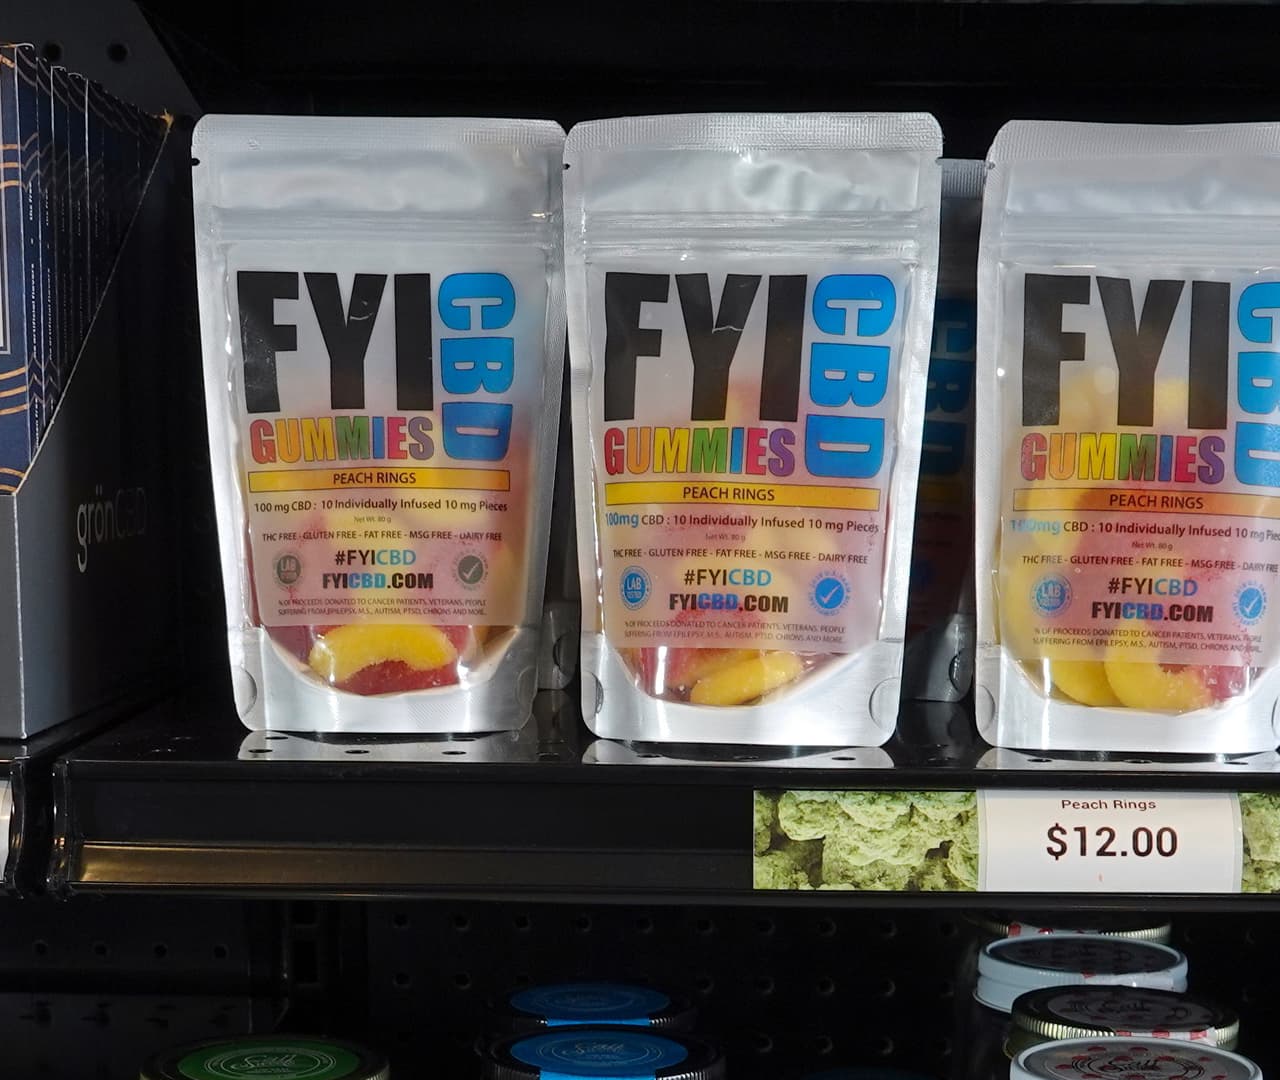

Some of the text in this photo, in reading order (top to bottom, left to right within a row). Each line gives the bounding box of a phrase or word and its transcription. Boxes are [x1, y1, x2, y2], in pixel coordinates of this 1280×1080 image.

[236, 270, 434, 414] FYI
[603, 272, 808, 423] FYI
[438, 272, 516, 461] CBD
[249, 416, 435, 464] GUMMIES
[603, 427, 797, 478] GUMMIES
[1020, 431, 1227, 484] GUMMIES
[333, 473, 417, 485] PEACH RINGS
[254, 499, 508, 514] 100 mg CBD 10 Individually Infused 10 mg Pieces
[334, 549, 417, 566] #FYICBD
[322, 572, 434, 589] FYICBD.COM
[1061, 799, 1156, 812] Peach Rings
[1046, 822, 1178, 861] $12.00
